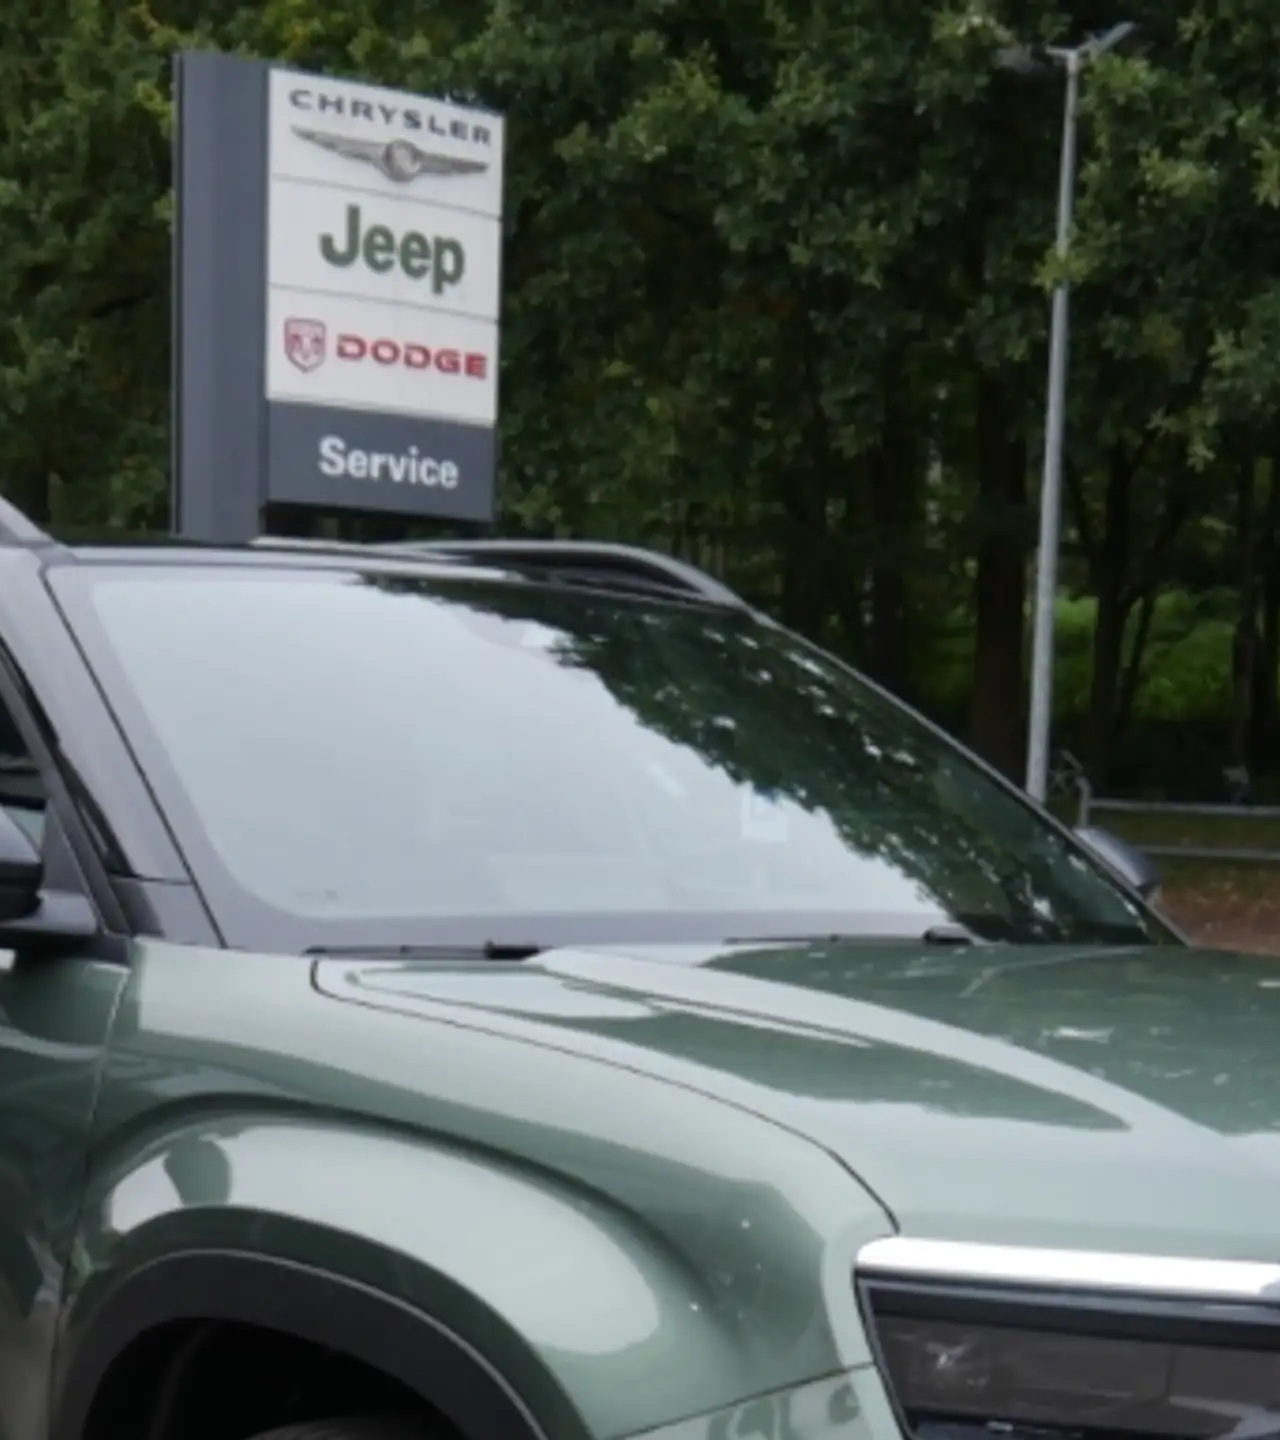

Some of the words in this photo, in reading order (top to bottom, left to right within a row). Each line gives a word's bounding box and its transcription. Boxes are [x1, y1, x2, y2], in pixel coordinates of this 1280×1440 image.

[288, 88, 491, 145] CHRYSLER
[318, 204, 465, 294] Jeep
[336, 334, 487, 380] DODGE
[318, 436, 460, 488] Service
